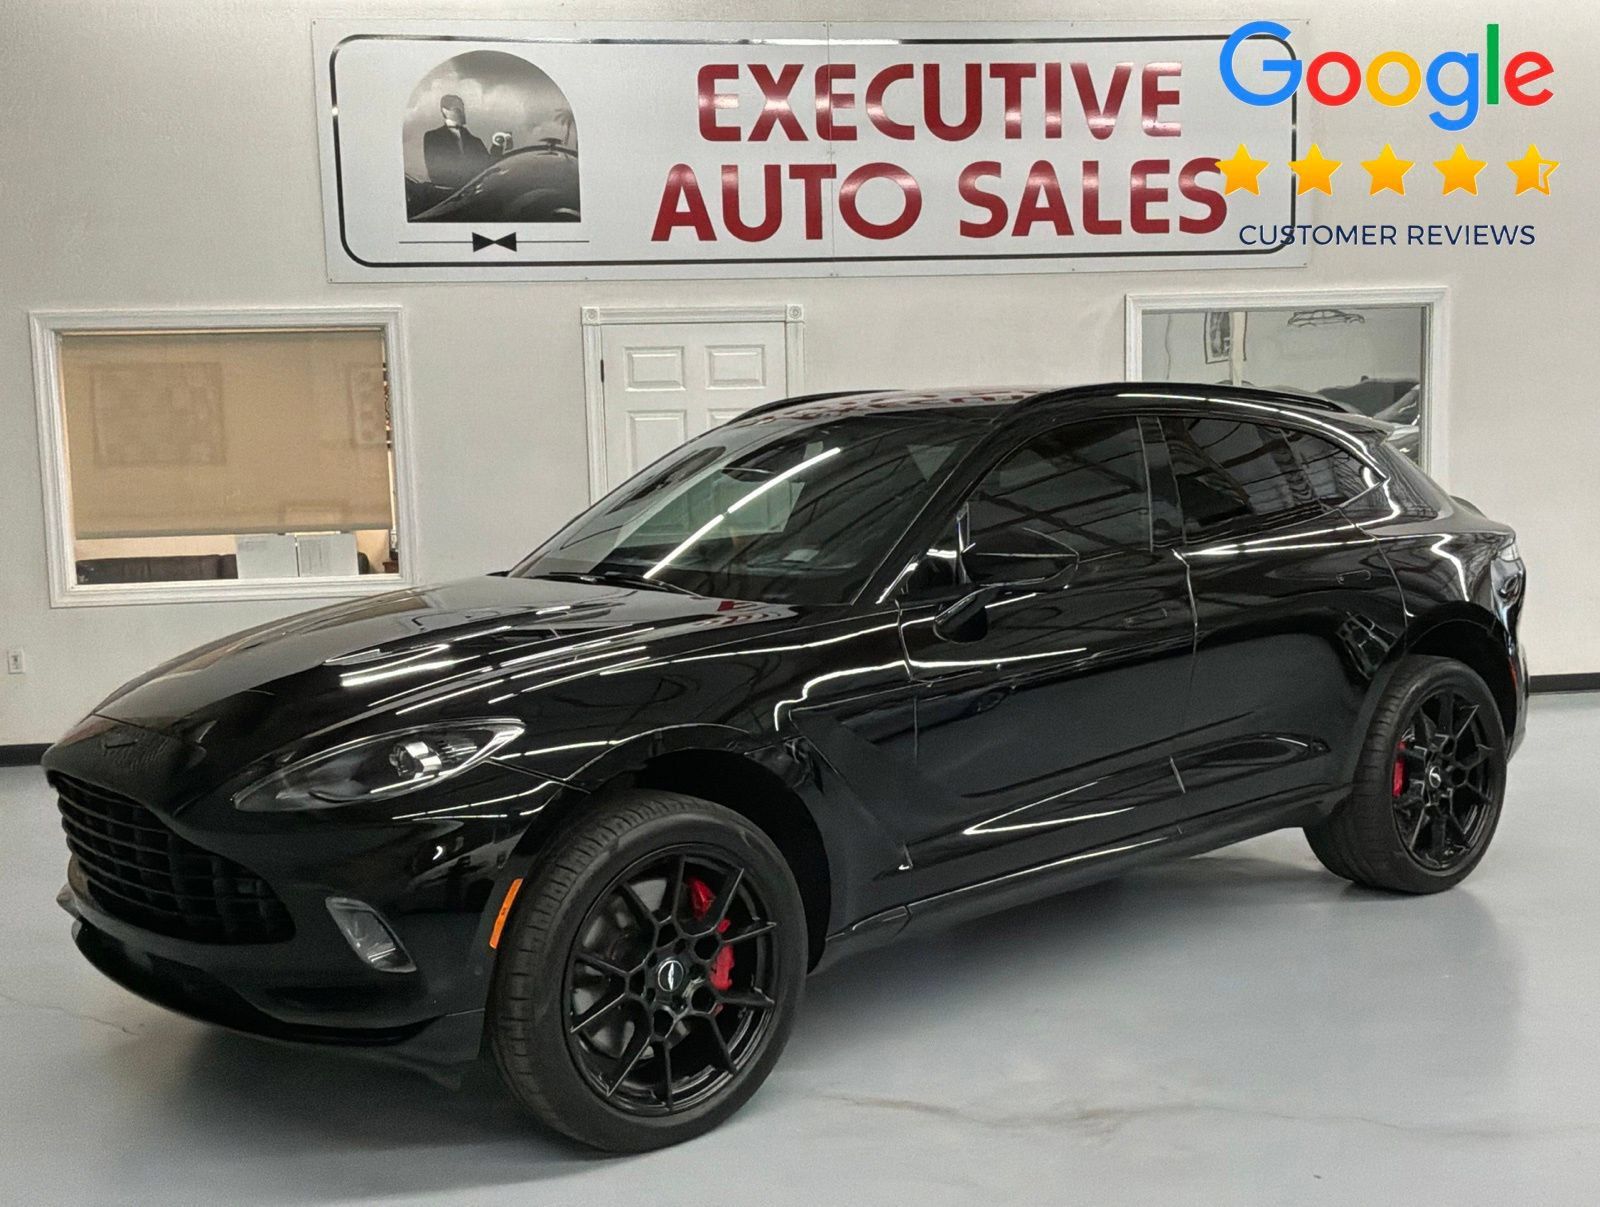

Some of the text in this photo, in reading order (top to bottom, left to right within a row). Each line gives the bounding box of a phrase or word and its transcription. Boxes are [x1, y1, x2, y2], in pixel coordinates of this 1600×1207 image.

[697, 61, 1182, 143] EXECUTIVE
[651, 156, 1227, 243] AUTO SALES
